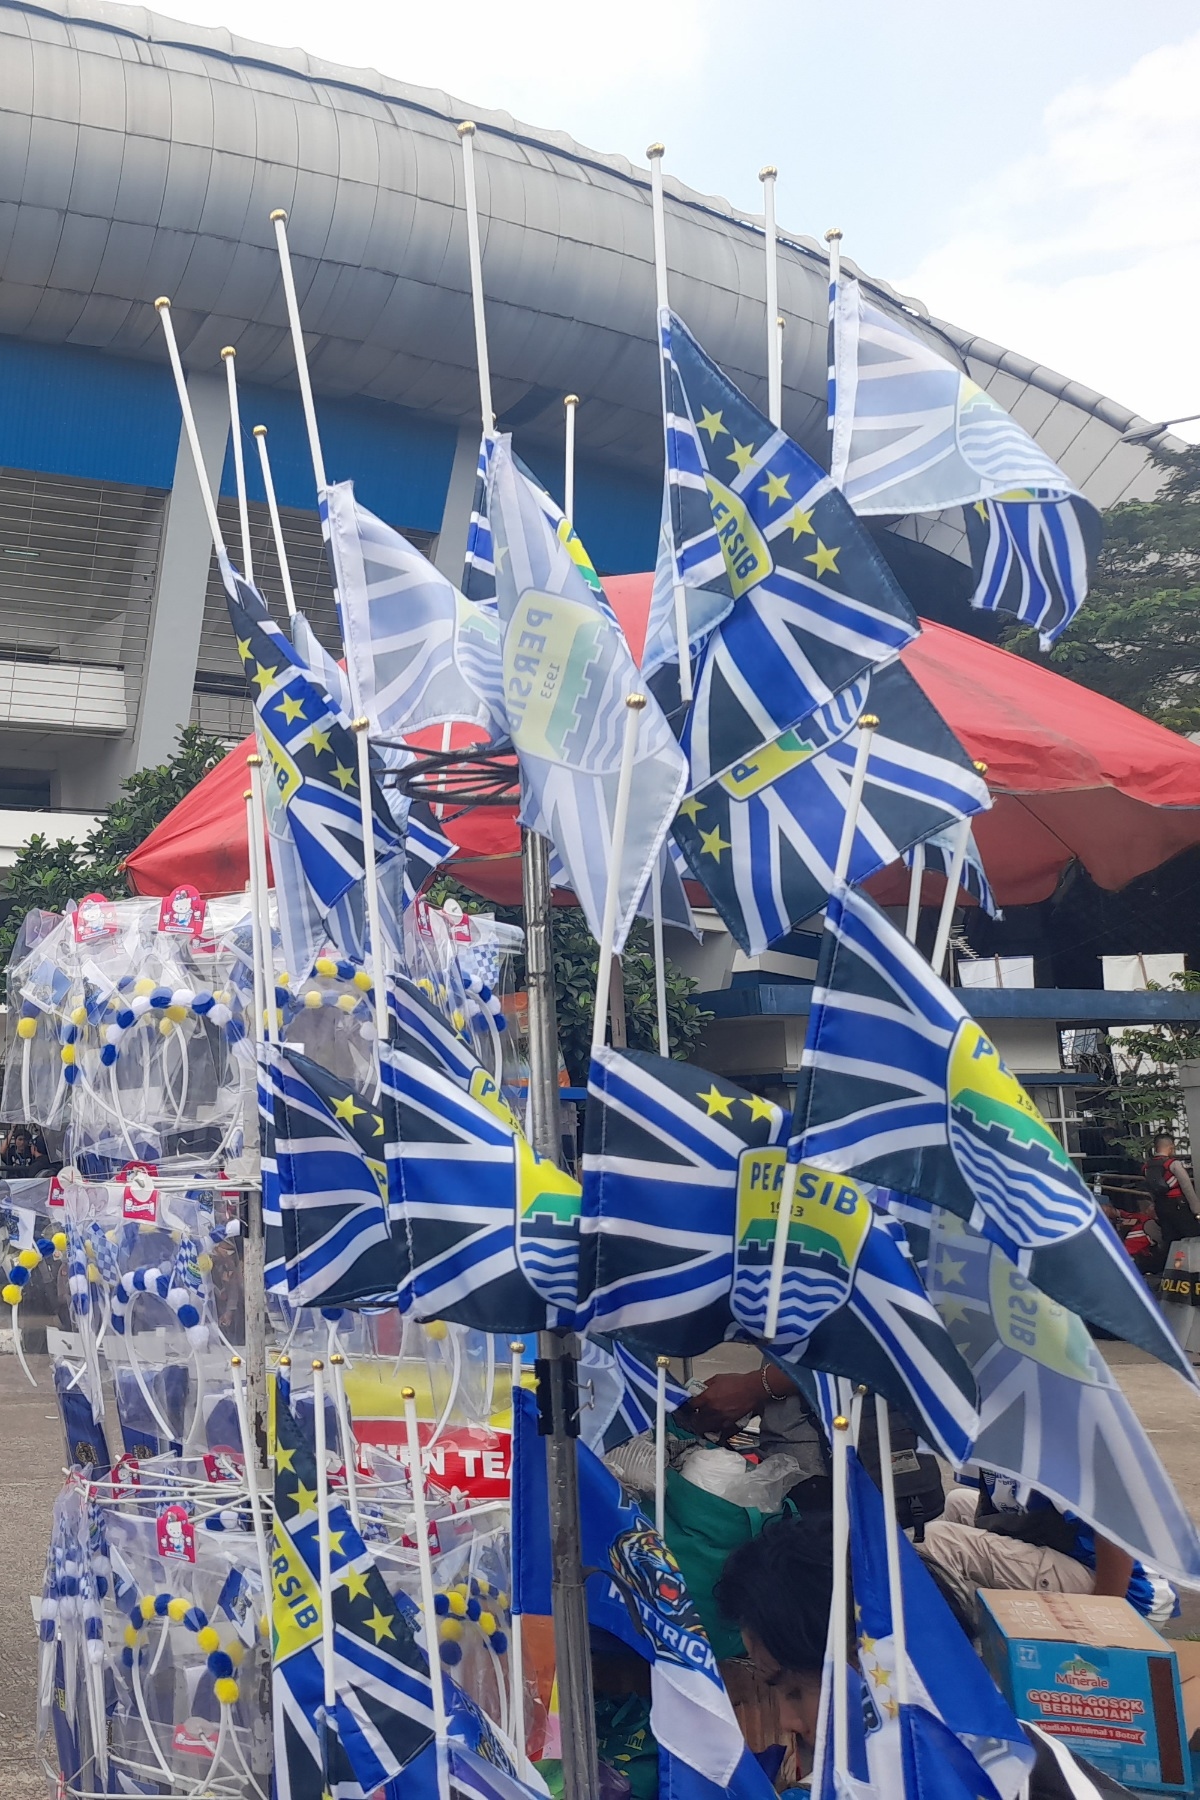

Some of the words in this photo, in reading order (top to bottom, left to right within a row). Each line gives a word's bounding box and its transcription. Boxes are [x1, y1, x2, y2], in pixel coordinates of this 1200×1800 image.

[1072, 1664, 1087, 1677] Le
[1056, 1673, 1109, 1688] Minerale
[1028, 1689, 1142, 1711] GOSOK-GOSOK
[1042, 1702, 1131, 1720] BERHADIAH
[1072, 1726, 1108, 1736] Minimal
